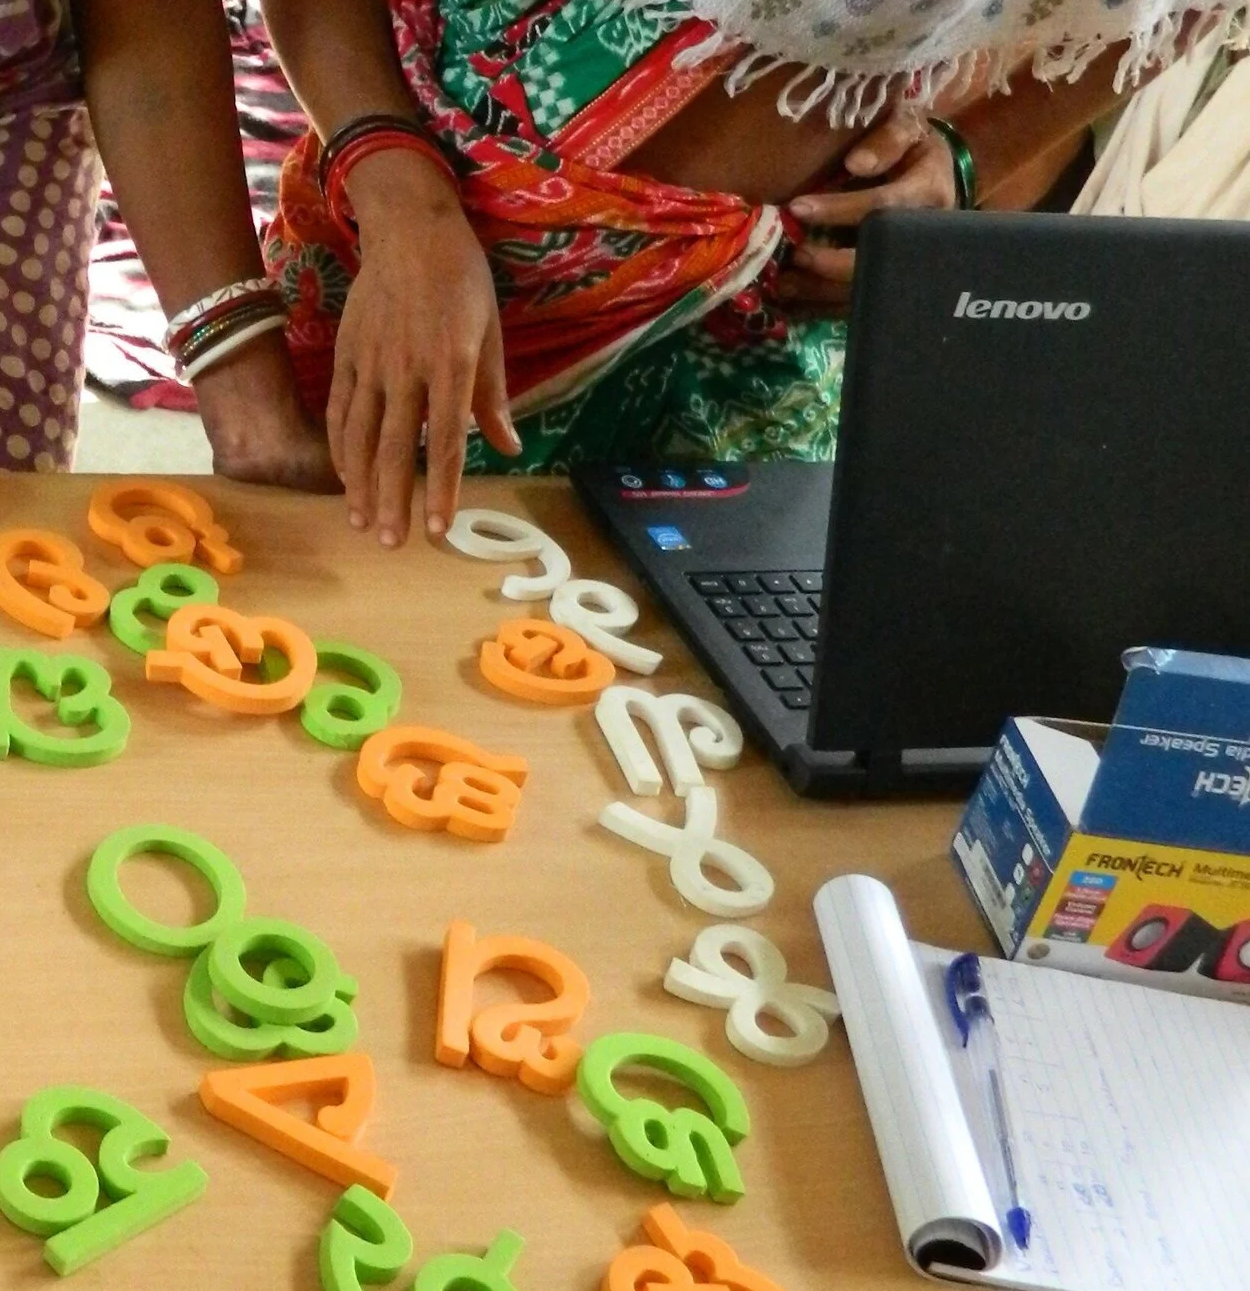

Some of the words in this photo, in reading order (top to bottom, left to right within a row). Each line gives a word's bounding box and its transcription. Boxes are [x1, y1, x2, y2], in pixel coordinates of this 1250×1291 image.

[953, 291, 1091, 321] lenovo
[1139, 732, 1221, 758] Speaker
[1085, 852, 1184, 881] FRONTECH
